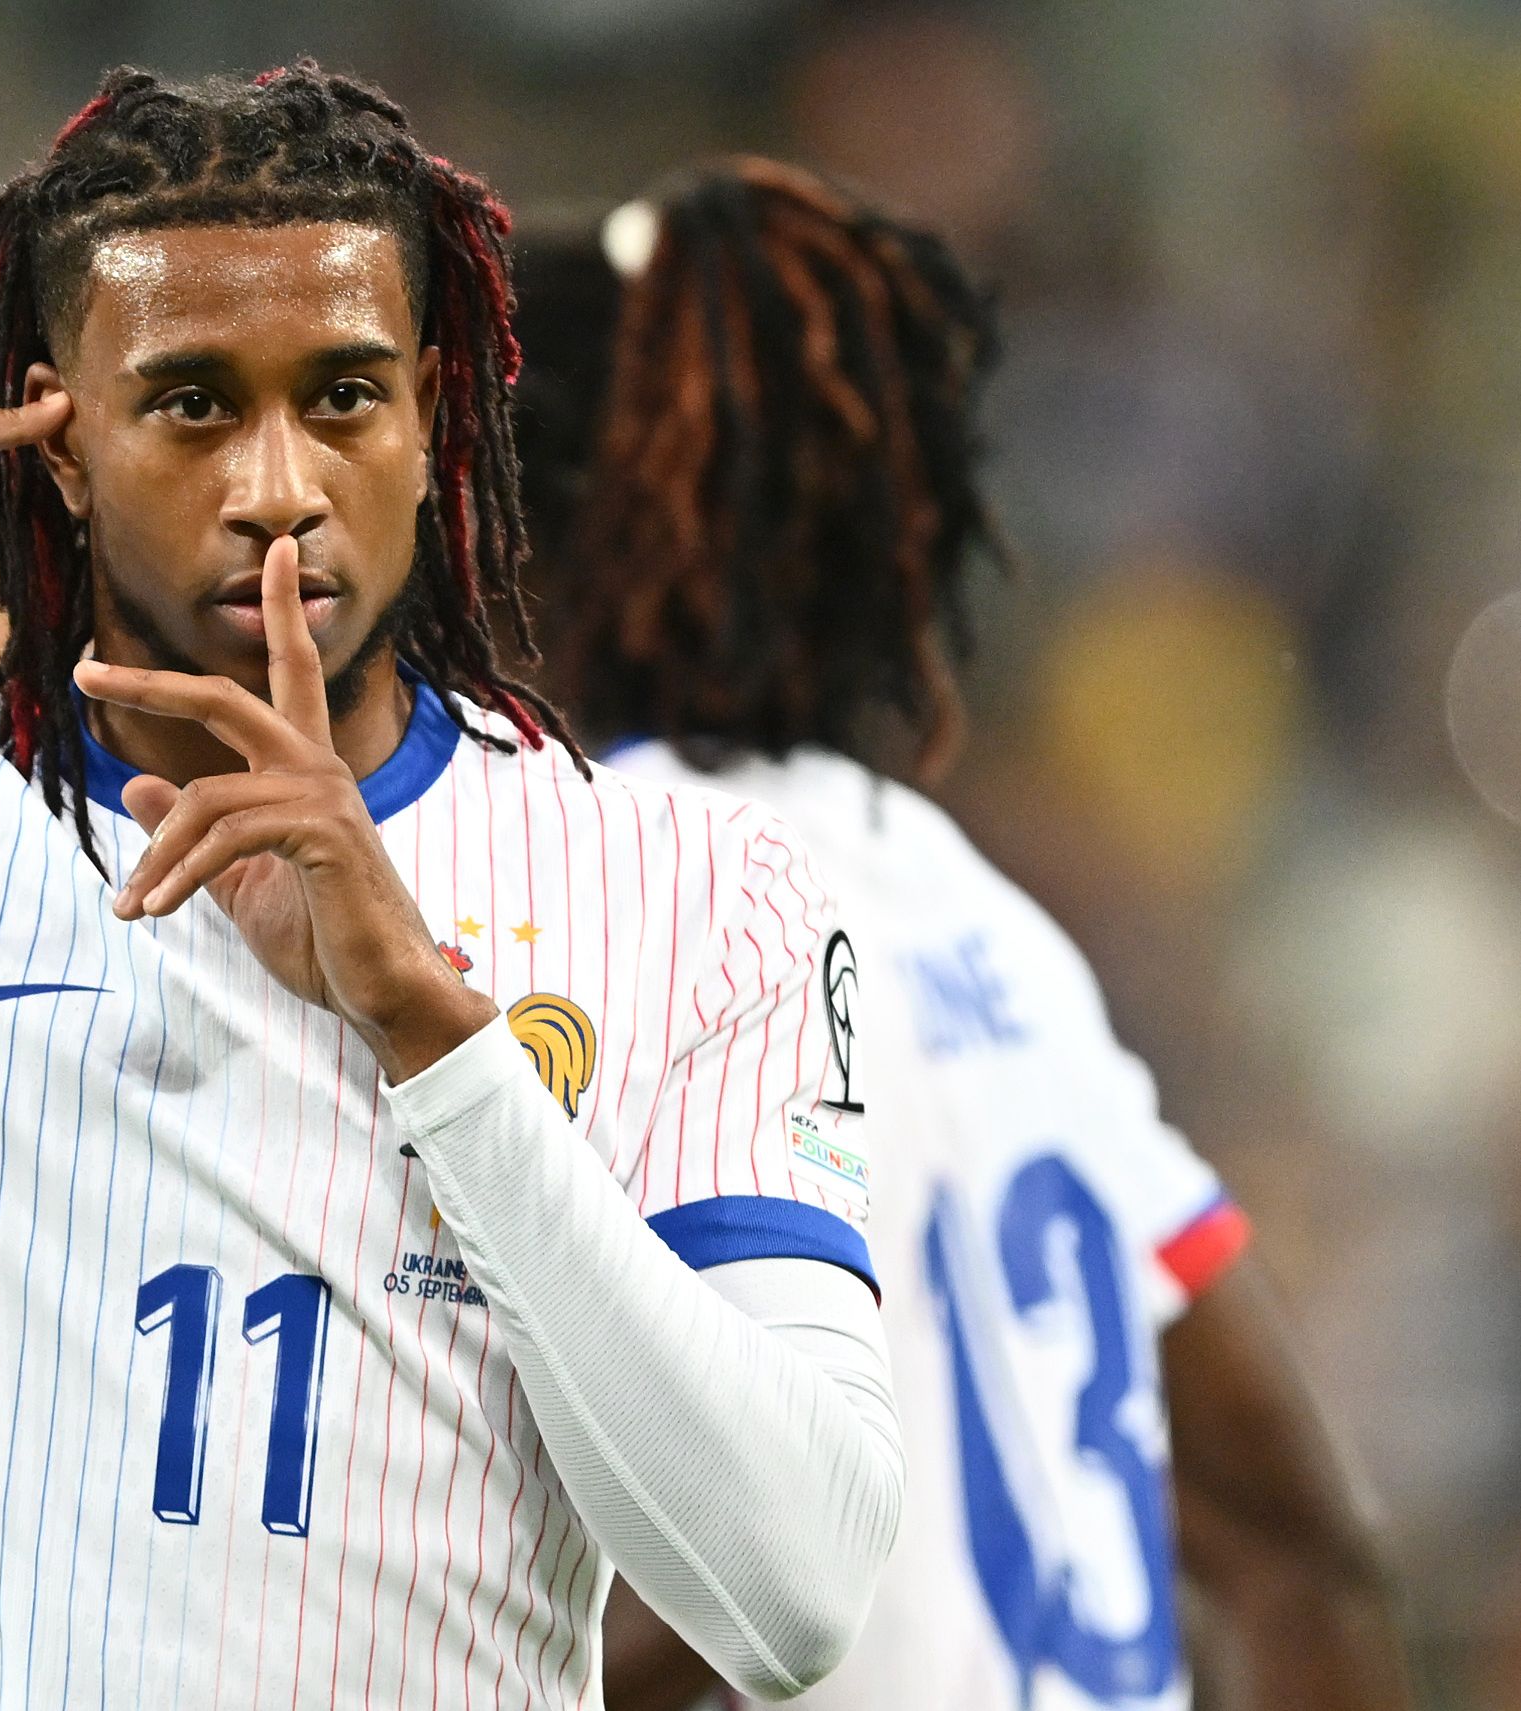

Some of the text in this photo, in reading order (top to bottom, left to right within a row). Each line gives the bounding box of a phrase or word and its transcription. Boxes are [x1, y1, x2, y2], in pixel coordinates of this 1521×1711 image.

[791, 1112, 819, 1133] UEFA
[383, 1272, 410, 1294] 05
[135, 1263, 332, 1538] 11
